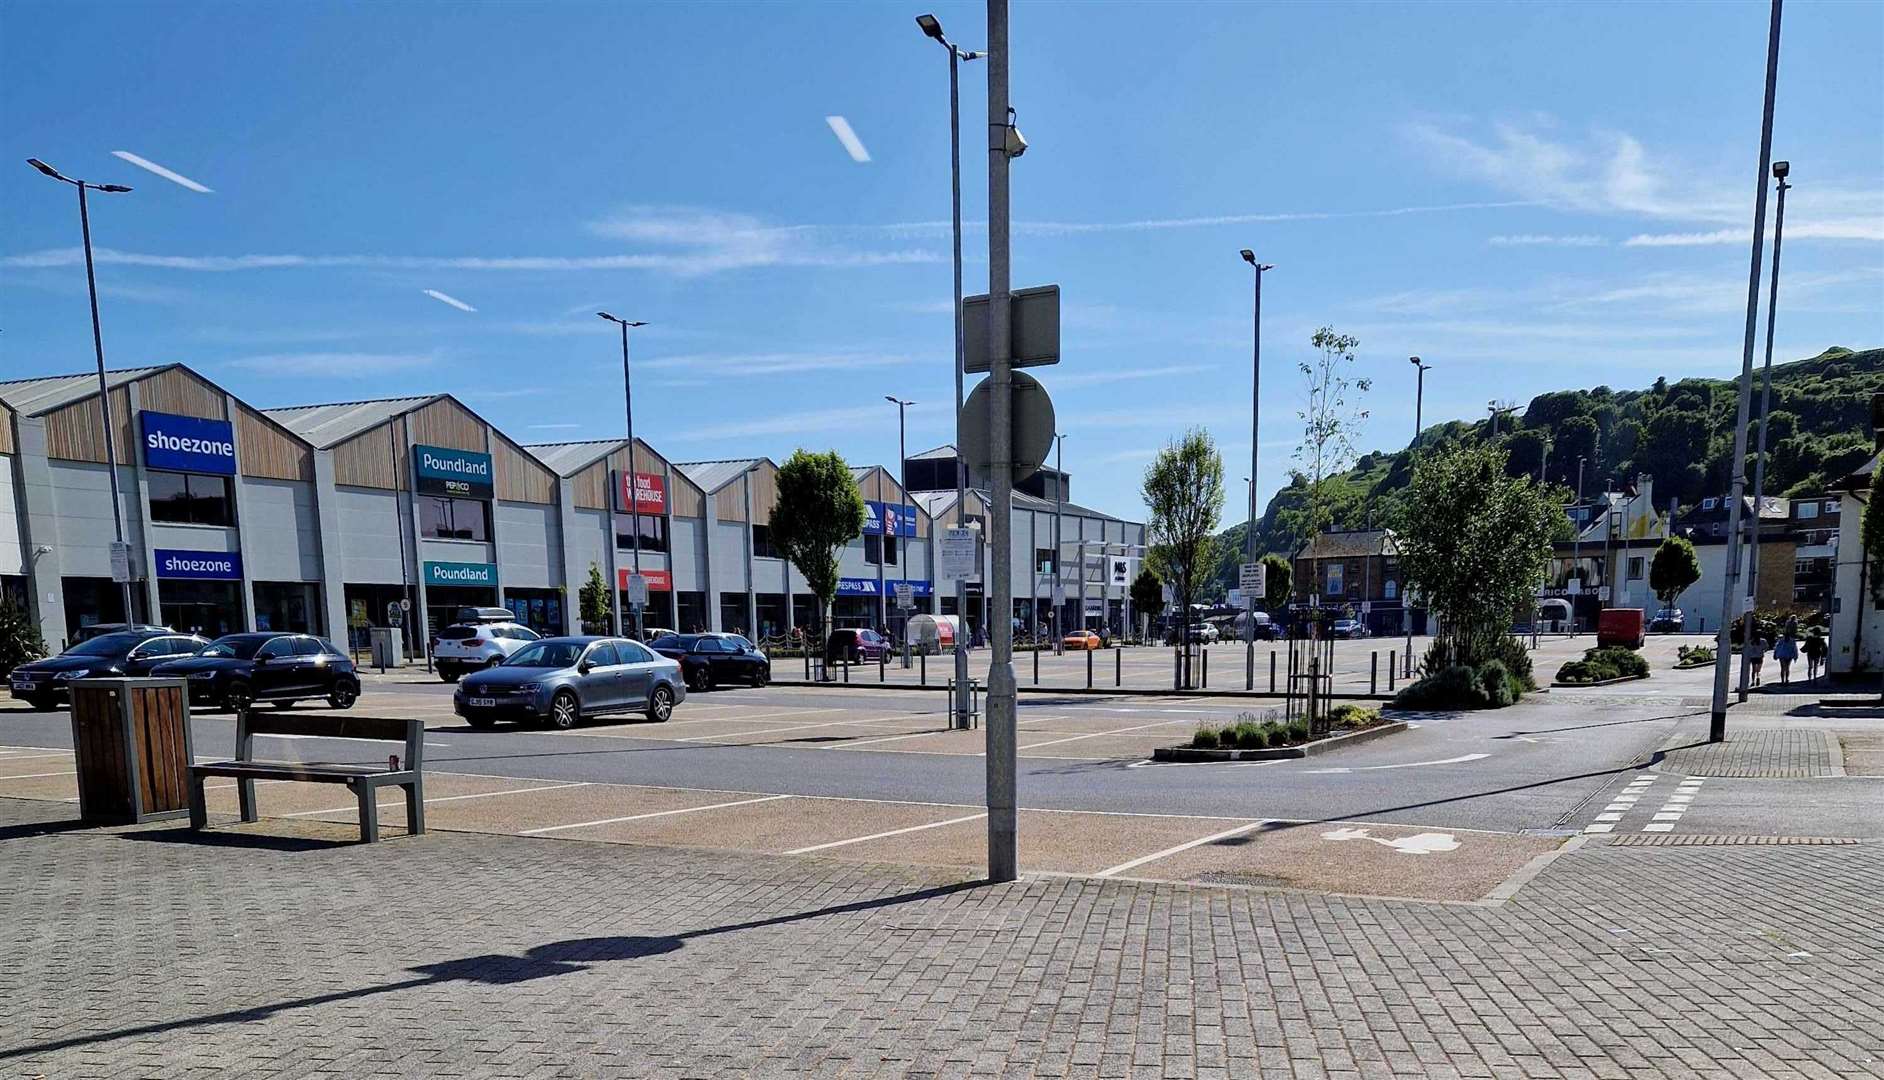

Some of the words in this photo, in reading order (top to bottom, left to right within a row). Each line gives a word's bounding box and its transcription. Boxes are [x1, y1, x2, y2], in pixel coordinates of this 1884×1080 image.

[148, 430, 233, 456] shoezone
[423, 453, 487, 475] Poundland
[626, 488, 663, 503] WREHOUSE
[165, 556, 232, 571] shoezone
[433, 566, 488, 580] Poundland
[837, 580, 862, 591] RESPASS
